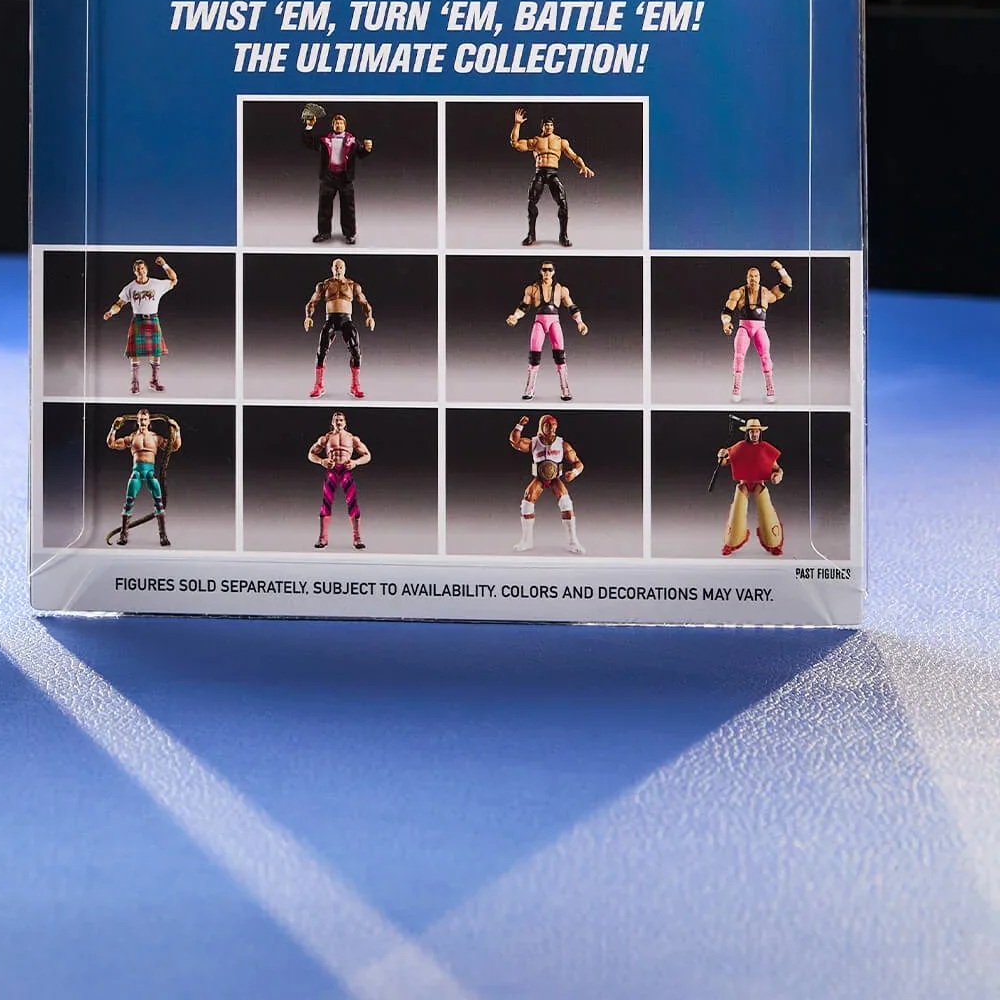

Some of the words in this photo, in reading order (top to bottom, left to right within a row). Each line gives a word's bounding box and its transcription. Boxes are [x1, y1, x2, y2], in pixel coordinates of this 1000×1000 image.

[170, 0, 267, 30] TWIST
[349, 0, 431, 30] TURN
[513, 0, 626, 31] BATTLE
[233, 42, 290, 72] THE
[296, 42, 448, 72] ULTIMATE
[453, 42, 649, 73] COLLECTION!
[795, 568, 815, 579] PAST
[817, 568, 851, 579] FIGURES
[115, 577, 175, 591] FIGURES
[179, 578, 216, 592] SOLD
[220, 579, 309, 595] SEPARATELY.
[313, 581, 376, 595] SUBJECT
[379, 582, 397, 595] TO
[401, 583, 496, 597] AVAILABILITY.
[501, 584, 558, 598] COLORS
[562, 585, 593, 599] AND
[598, 586, 698, 600] DECORATIONS
[702, 587, 732, 600] MAY
[735, 588, 773, 601] VARY.
